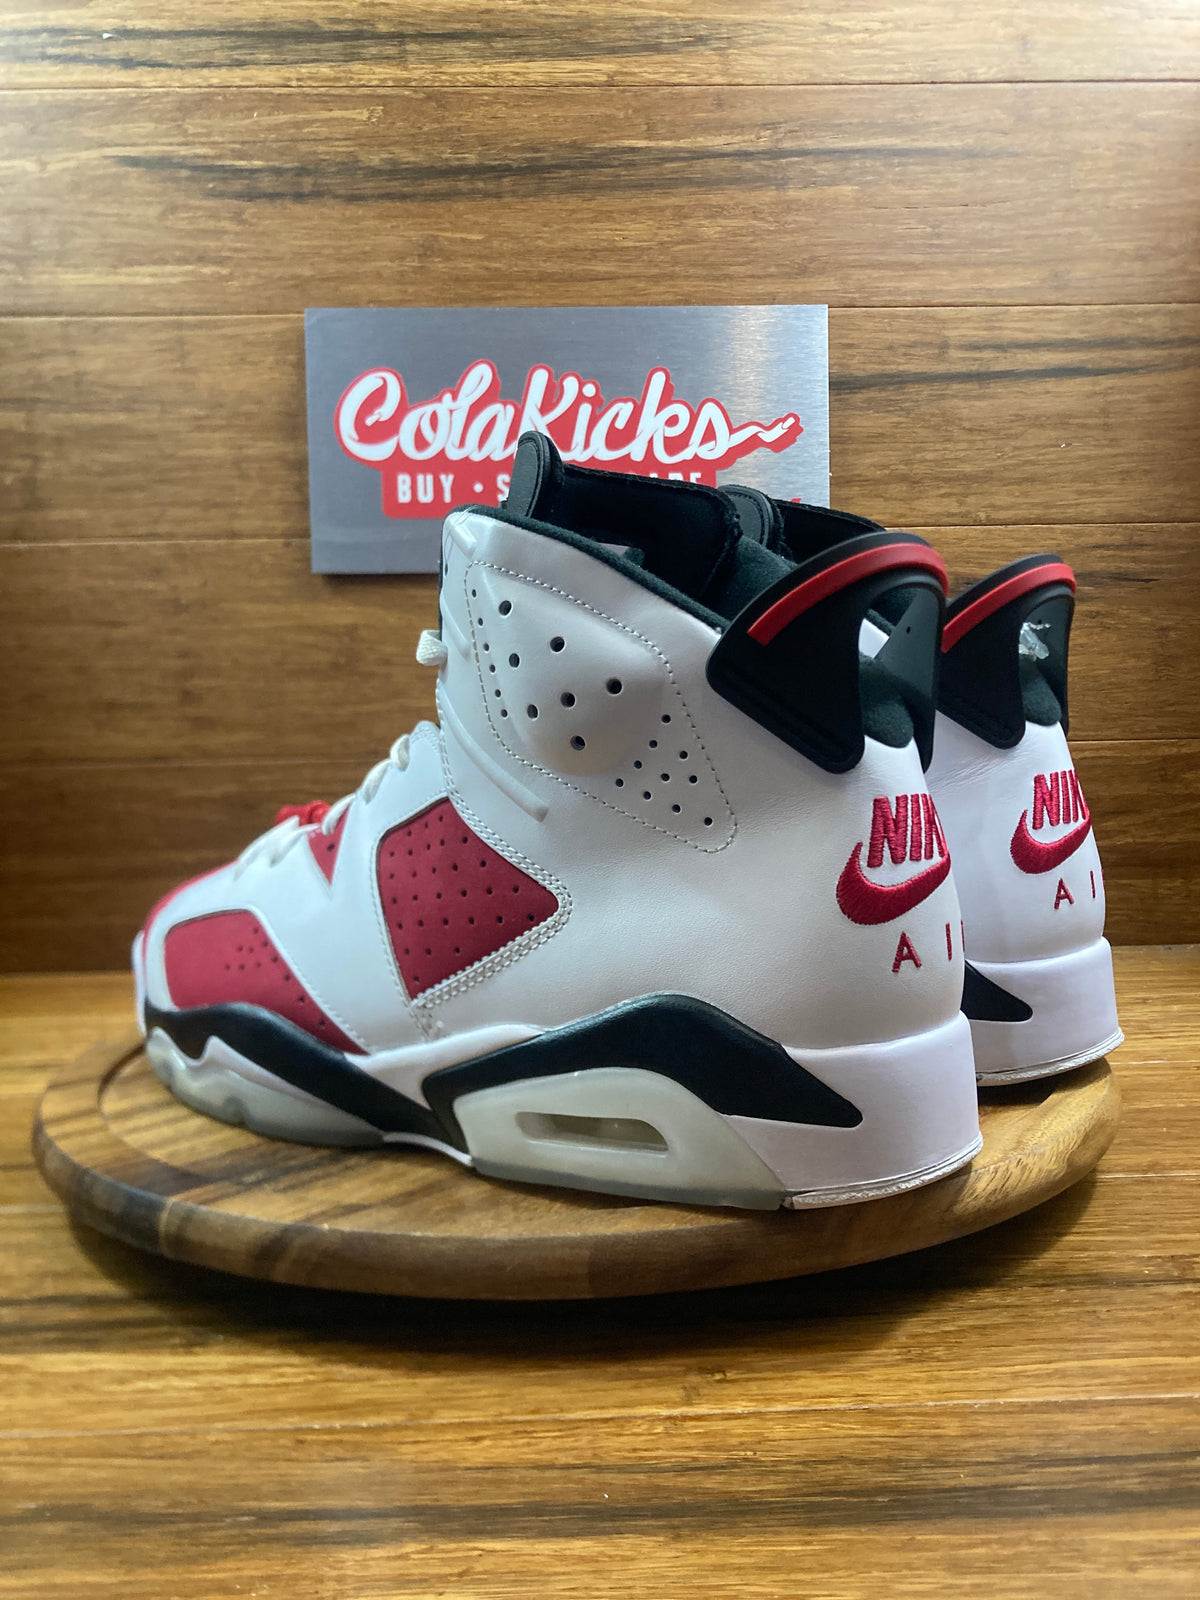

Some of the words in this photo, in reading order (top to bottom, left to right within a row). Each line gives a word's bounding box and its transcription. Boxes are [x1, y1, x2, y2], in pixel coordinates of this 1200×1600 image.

[338, 359, 796, 464] ColaKicks
[397, 473, 454, 503] BUY
[1032, 769, 1090, 830] NIK
[867, 793, 948, 868] NIK
[1054, 869, 1106, 910] AI
[892, 919, 965, 973] AI
